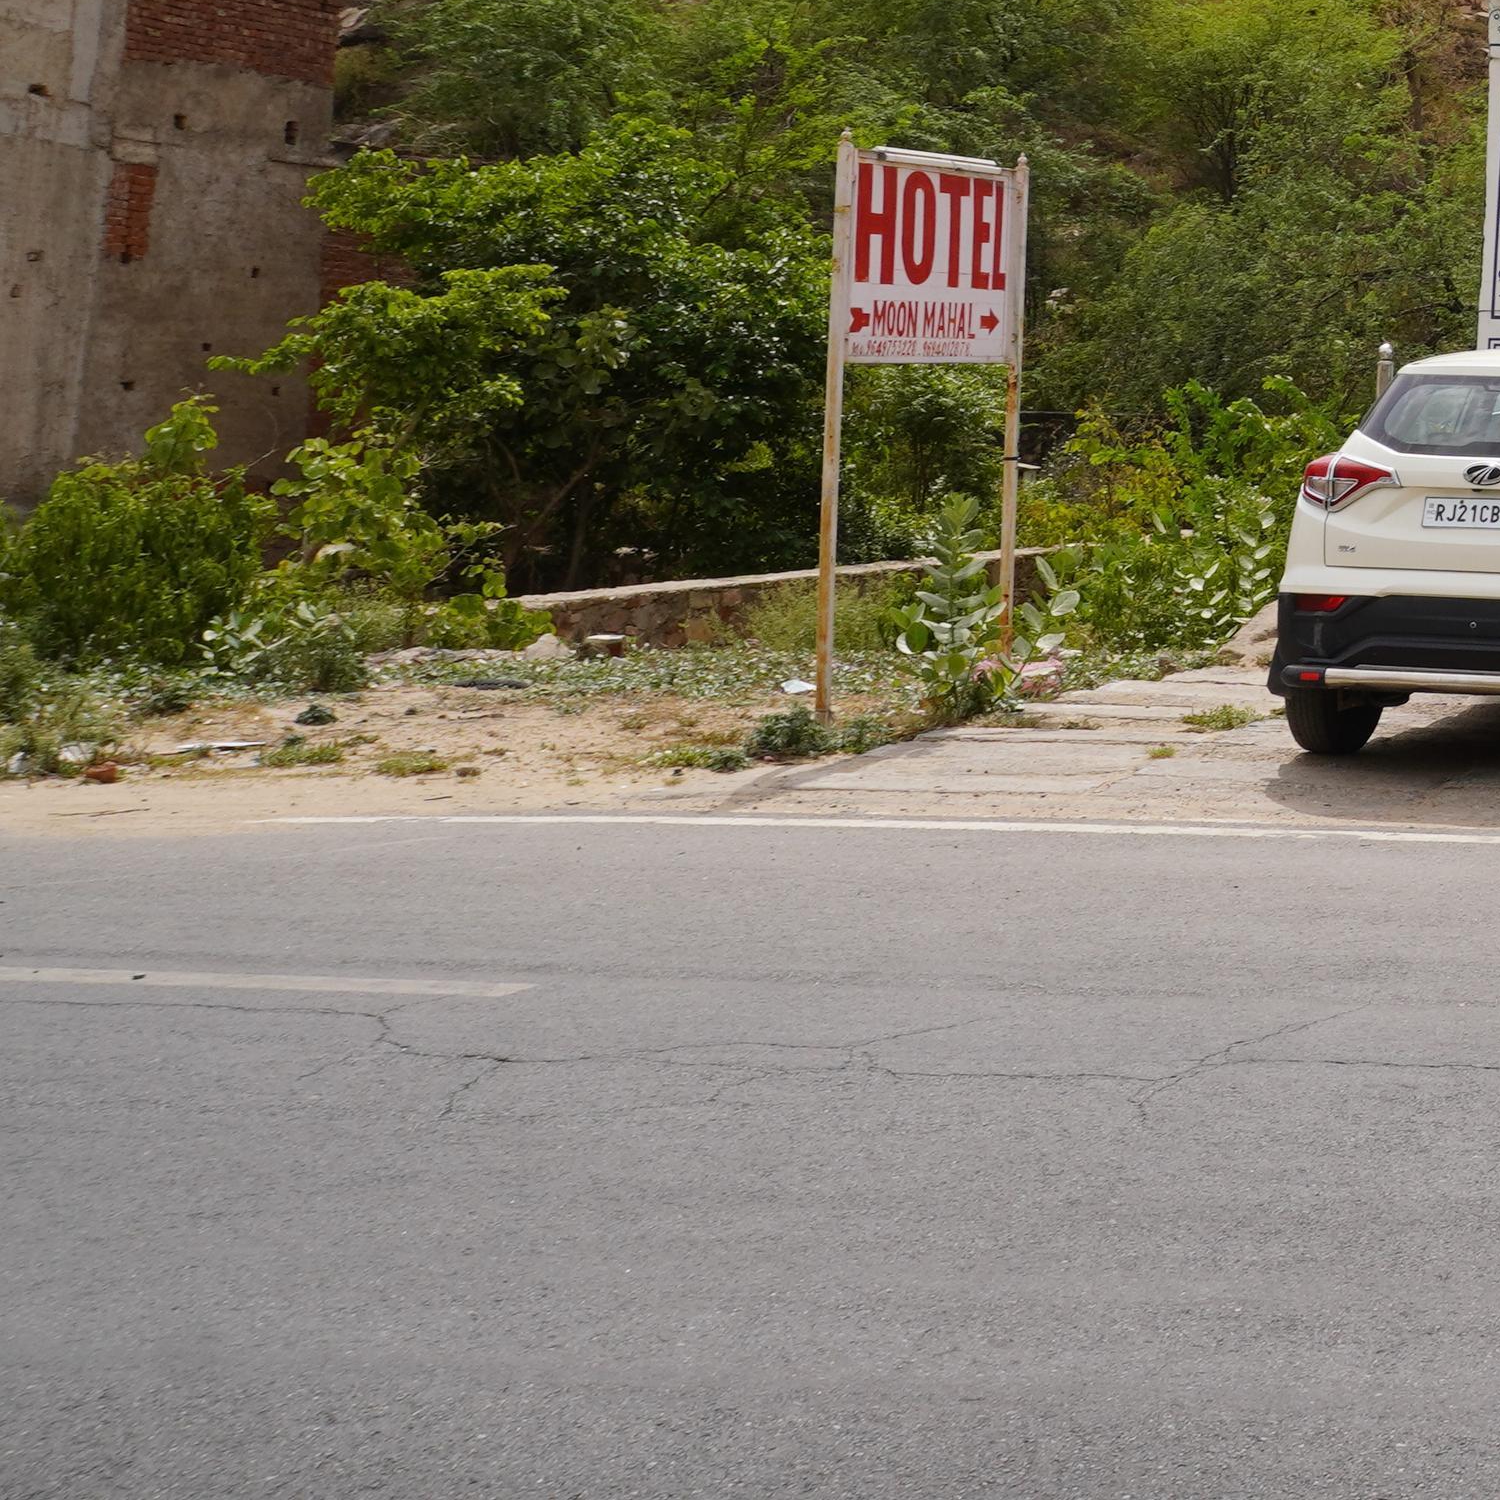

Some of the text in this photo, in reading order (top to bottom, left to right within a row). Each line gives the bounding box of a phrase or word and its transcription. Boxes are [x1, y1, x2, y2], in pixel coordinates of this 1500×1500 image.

[854, 162, 1006, 290] HOTEL
[872, 300, 976, 339] MOON MAHAL
